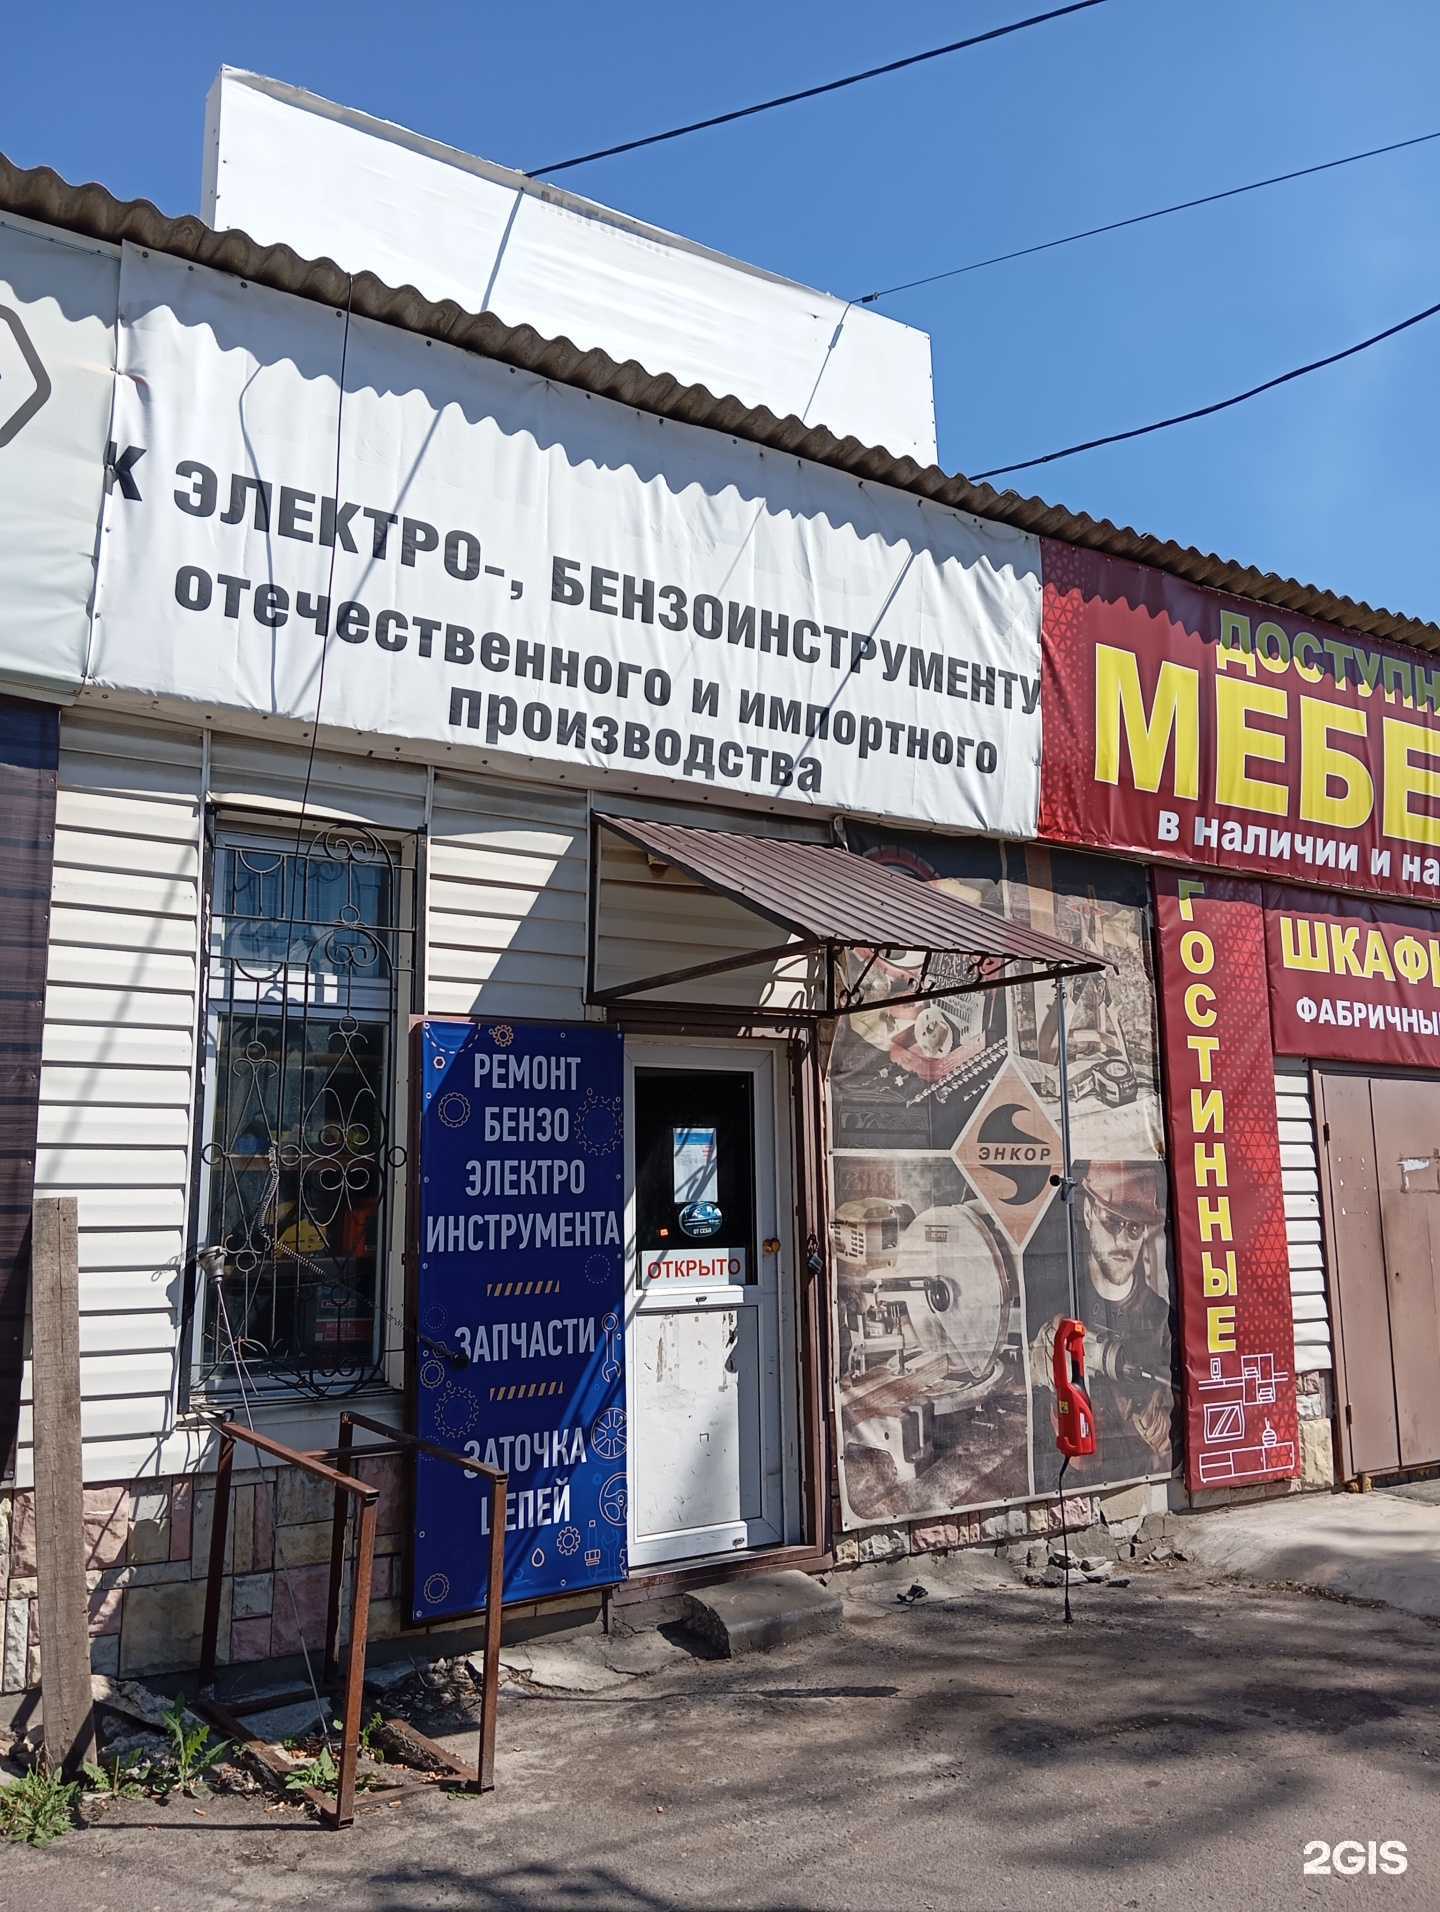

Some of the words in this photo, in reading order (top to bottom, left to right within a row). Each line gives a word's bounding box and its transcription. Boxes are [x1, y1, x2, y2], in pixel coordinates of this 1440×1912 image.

[104, 441, 148, 501] К
[174, 460, 524, 600] ЭЛЕКТРО-,
[551, 556, 1041, 715] БЕНЗОИНСТРУМЕНТУ
[174, 565, 672, 706] отечественного
[692, 678, 719, 718] и
[739, 687, 998, 774] импортного
[1216, 609, 1440, 717] ДОСТУПН
[448, 686, 823, 793] производства
[1094, 642, 1440, 847] МЕБЕ
[1158, 810, 1180, 842] в
[1194, 816, 1359, 872] наличии
[1371, 848, 1391, 878] и
[1402, 853, 1440, 887] на
[1296, 996, 1440, 1036] ФАБРИЧНЫ
[473, 1053, 581, 1091] РЕМОНТ
[484, 1106, 569, 1142] БЕНЗО
[1178, 879, 1238, 1353] ГОСТИННЫЕ
[465, 1159, 586, 1197] ЭЛЕКТРО
[978, 1146, 1051, 1161] ЭНКОР
[426, 1210, 621, 1253] ИНСТРУМЕНТА
[647, 1258, 741, 1280] ОТКРЫТО
[454, 1316, 596, 1364] ЗАПЧАСТИ
[463, 1427, 587, 1479] ЗАТОЧКА
